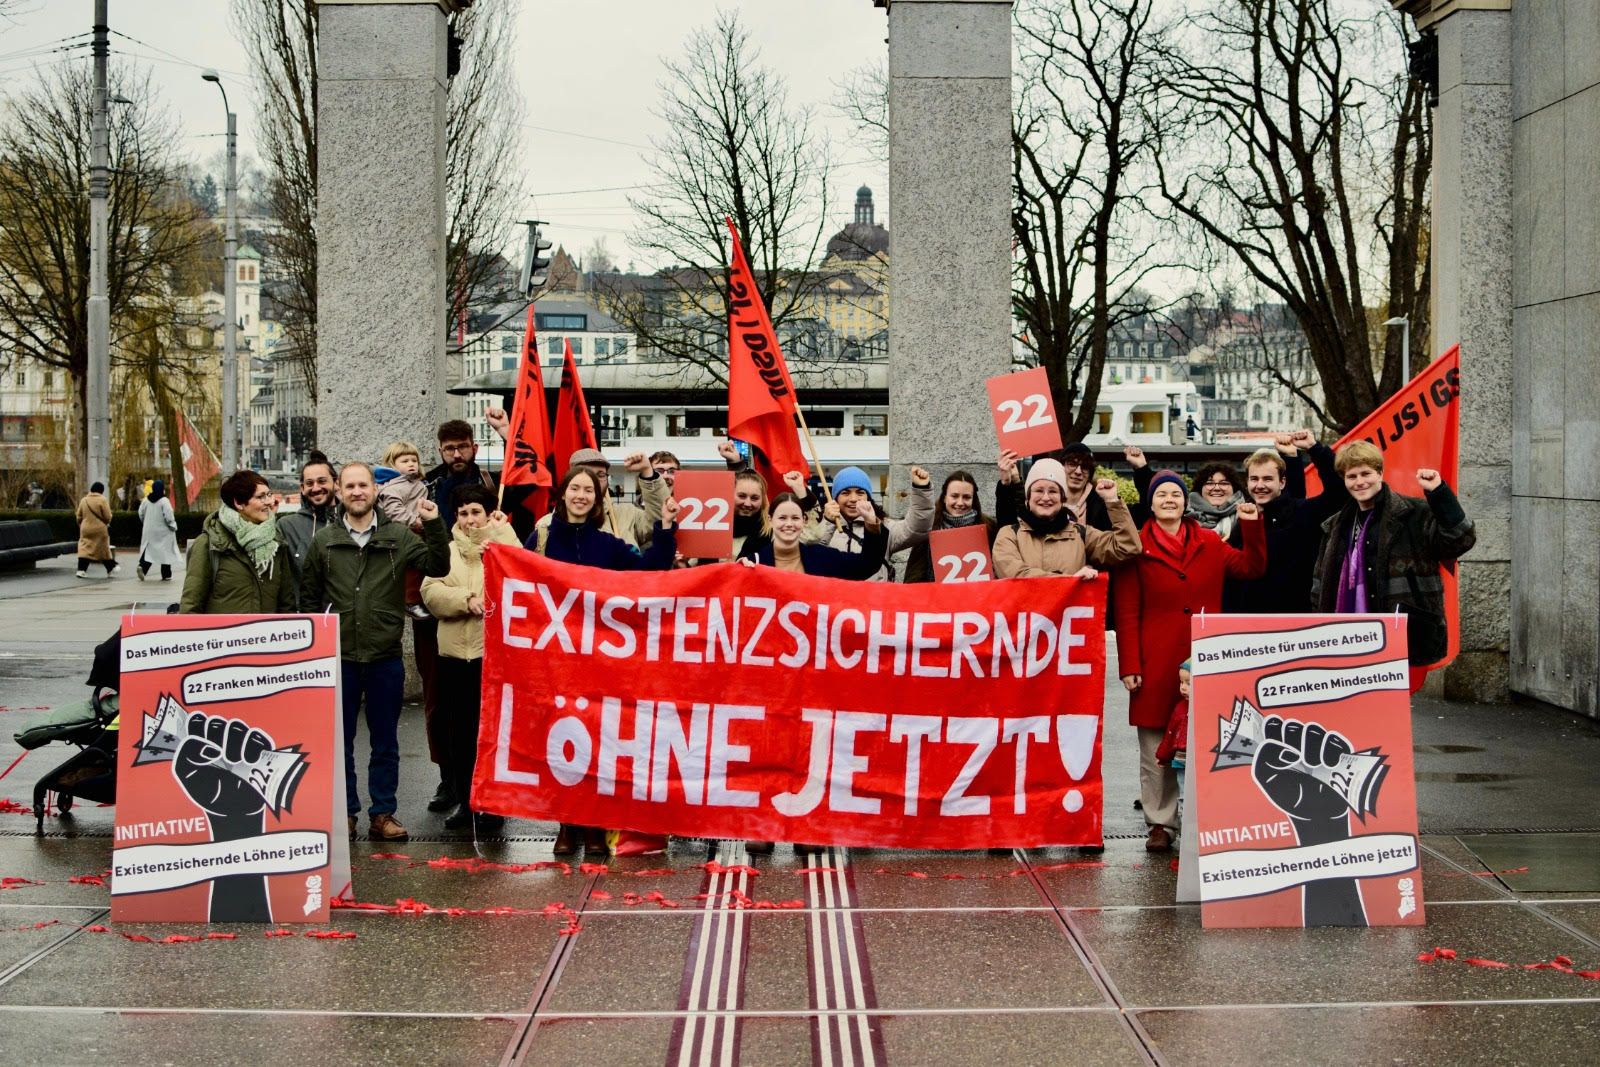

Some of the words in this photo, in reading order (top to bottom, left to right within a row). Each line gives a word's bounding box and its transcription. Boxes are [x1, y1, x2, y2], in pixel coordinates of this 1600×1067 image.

[997, 393, 1053, 433] 22
[1390, 402, 1420, 443] JS
[678, 497, 730, 531] 22
[937, 551, 991, 583] 22
[126, 647, 148, 660] Das
[149, 642, 204, 657] Mindeste
[206, 639, 225, 650] für
[226, 635, 267, 649] unsere
[269, 629, 307, 643] Arbeit
[501, 577, 1095, 679] EXISTENZSICHERNDE
[1197, 650, 1220, 662] Das
[1221, 645, 1277, 660] Mindeste
[1278, 641, 1296, 653] für
[1298, 637, 1338, 651] unsere
[1341, 631, 1378, 645] Arbeit
[188, 682, 203, 694] 22
[205, 677, 254, 692] Franken
[256, 668, 331, 686] Mindestlohn
[1262, 686, 1277, 697] 22
[1279, 680, 1329, 696] Franken
[1330, 671, 1404, 689] Mindestlohn
[771, 709, 1099, 818] JETZT!
[116, 816, 207, 841] INITIATIVE
[1199, 822, 1291, 847] INITIATIVE
[115, 853, 241, 877] Existenzsichernde
[243, 848, 286, 863] Löhne
[288, 843, 324, 861] jetzt!
[1202, 857, 1330, 883] Existenzsichernde
[1332, 852, 1375, 866] Löhne
[1376, 846, 1413, 863] jetzt!
